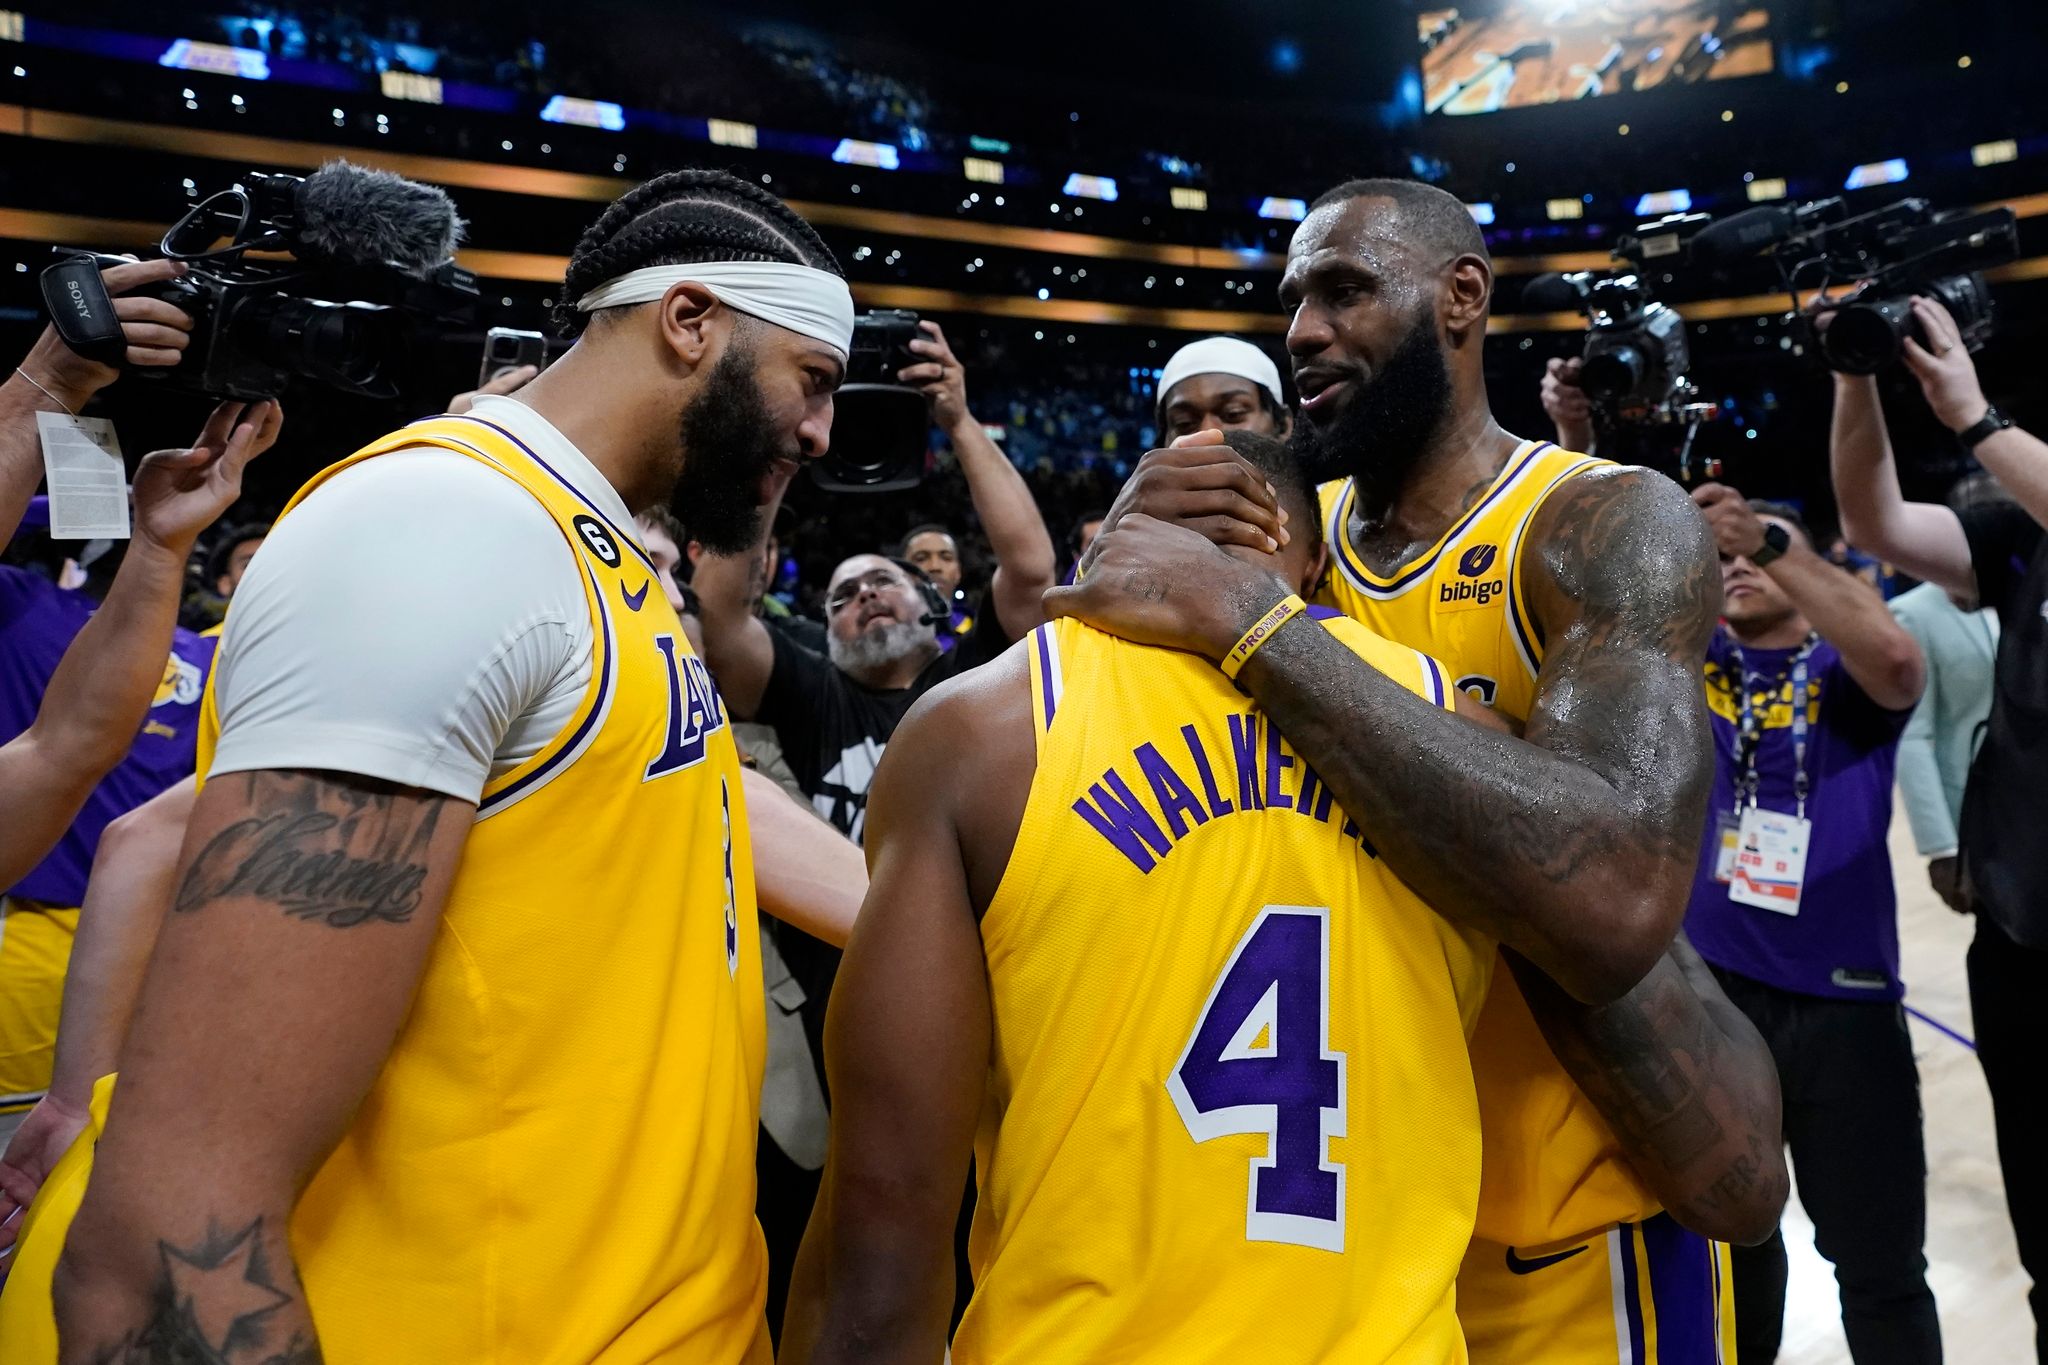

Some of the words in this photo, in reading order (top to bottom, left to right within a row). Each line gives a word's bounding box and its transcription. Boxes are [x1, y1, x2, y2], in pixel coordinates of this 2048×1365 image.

[67, 280, 92, 319] SONY
[580, 522, 616, 562] 6
[1440, 579, 1503, 605] bibigo
[1231, 653, 1241, 663] I
[1238, 604, 1292, 655] PROMISE
[1165, 904, 1348, 1254] 4
